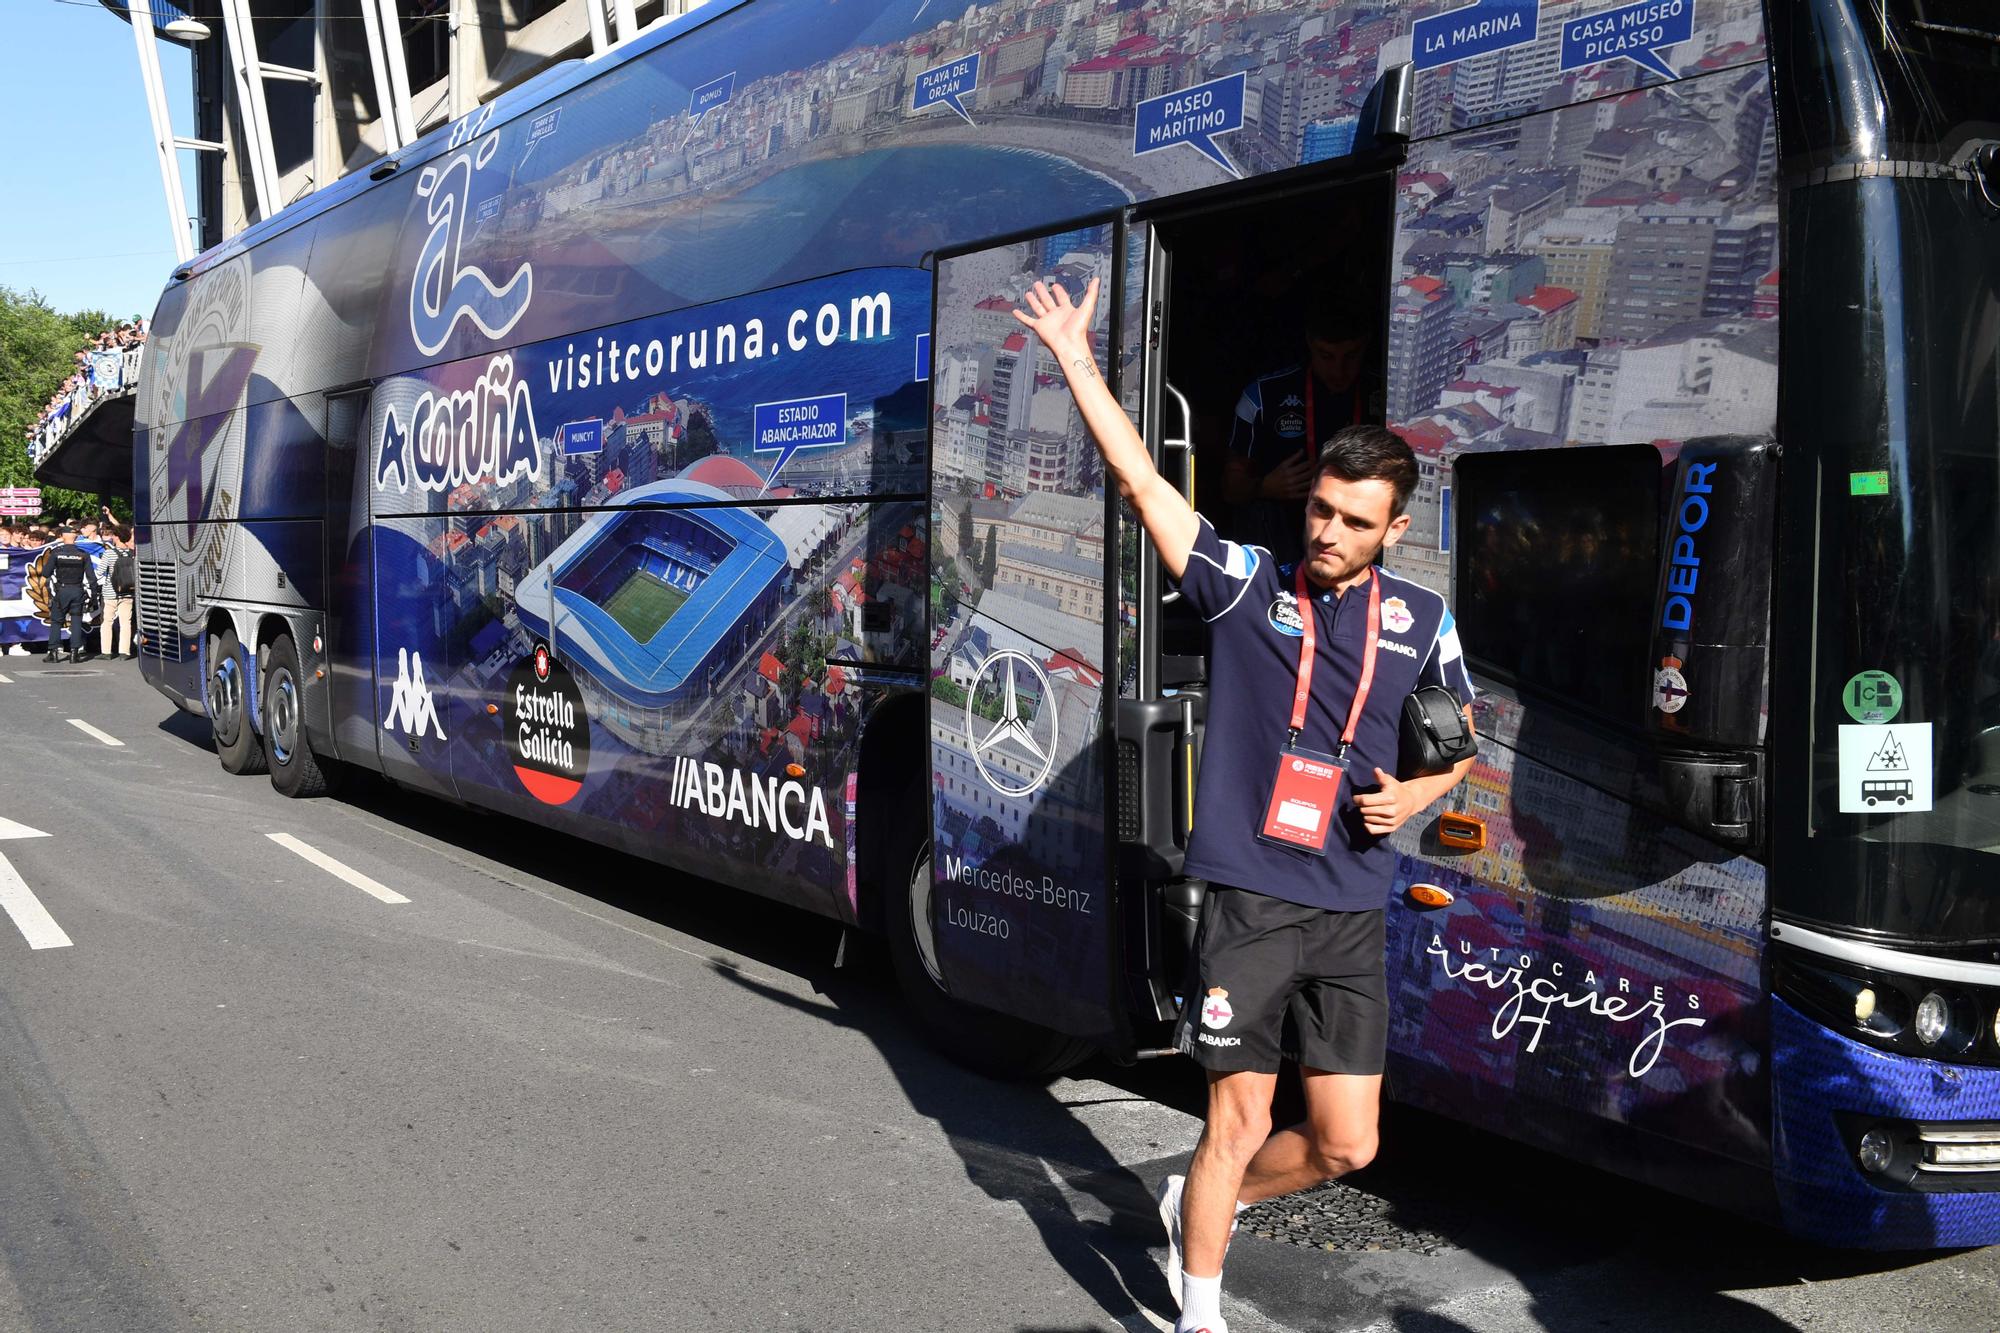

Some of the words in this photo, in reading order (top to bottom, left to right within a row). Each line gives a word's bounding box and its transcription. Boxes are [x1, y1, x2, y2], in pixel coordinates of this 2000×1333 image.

[1426, 33, 1446, 53] LA
[1452, 12, 1522, 47] MARINA
[1572, 18, 1616, 42] CASA
[1621, 1, 1682, 28] MUSEO
[1585, 26, 1664, 59] PICASSO
[923, 69, 950, 88] PLAYA
[953, 62, 969, 78] DEL
[929, 80, 960, 100] ORZÁN
[700, 87, 723, 105] DOMUS
[1164, 91, 1213, 119] PASEO
[1150, 109, 1226, 143] MARÍTIMO
[547, 291, 891, 394] visitcoruna.com
[156, 375, 175, 451] REAL
[761, 422, 837, 444] ABANCA-RIAZOR
[778, 405, 819, 423] ESTADIO
[376, 403, 407, 494] A
[571, 431, 594, 443] MUNCYT
[1663, 462, 1717, 630] DEPOR
[1378, 639, 1418, 660] ABANCA
[515, 683, 575, 730] Estrella
[518, 721, 574, 769] Galicia
[672, 756, 834, 848] ABANCA
[946, 854, 1092, 914] Mercedes-Benz
[947, 898, 1009, 939] Louzao
[1431, 934, 1700, 1010] AUTOCARES
[1199, 1032, 1241, 1047] ABANCA
